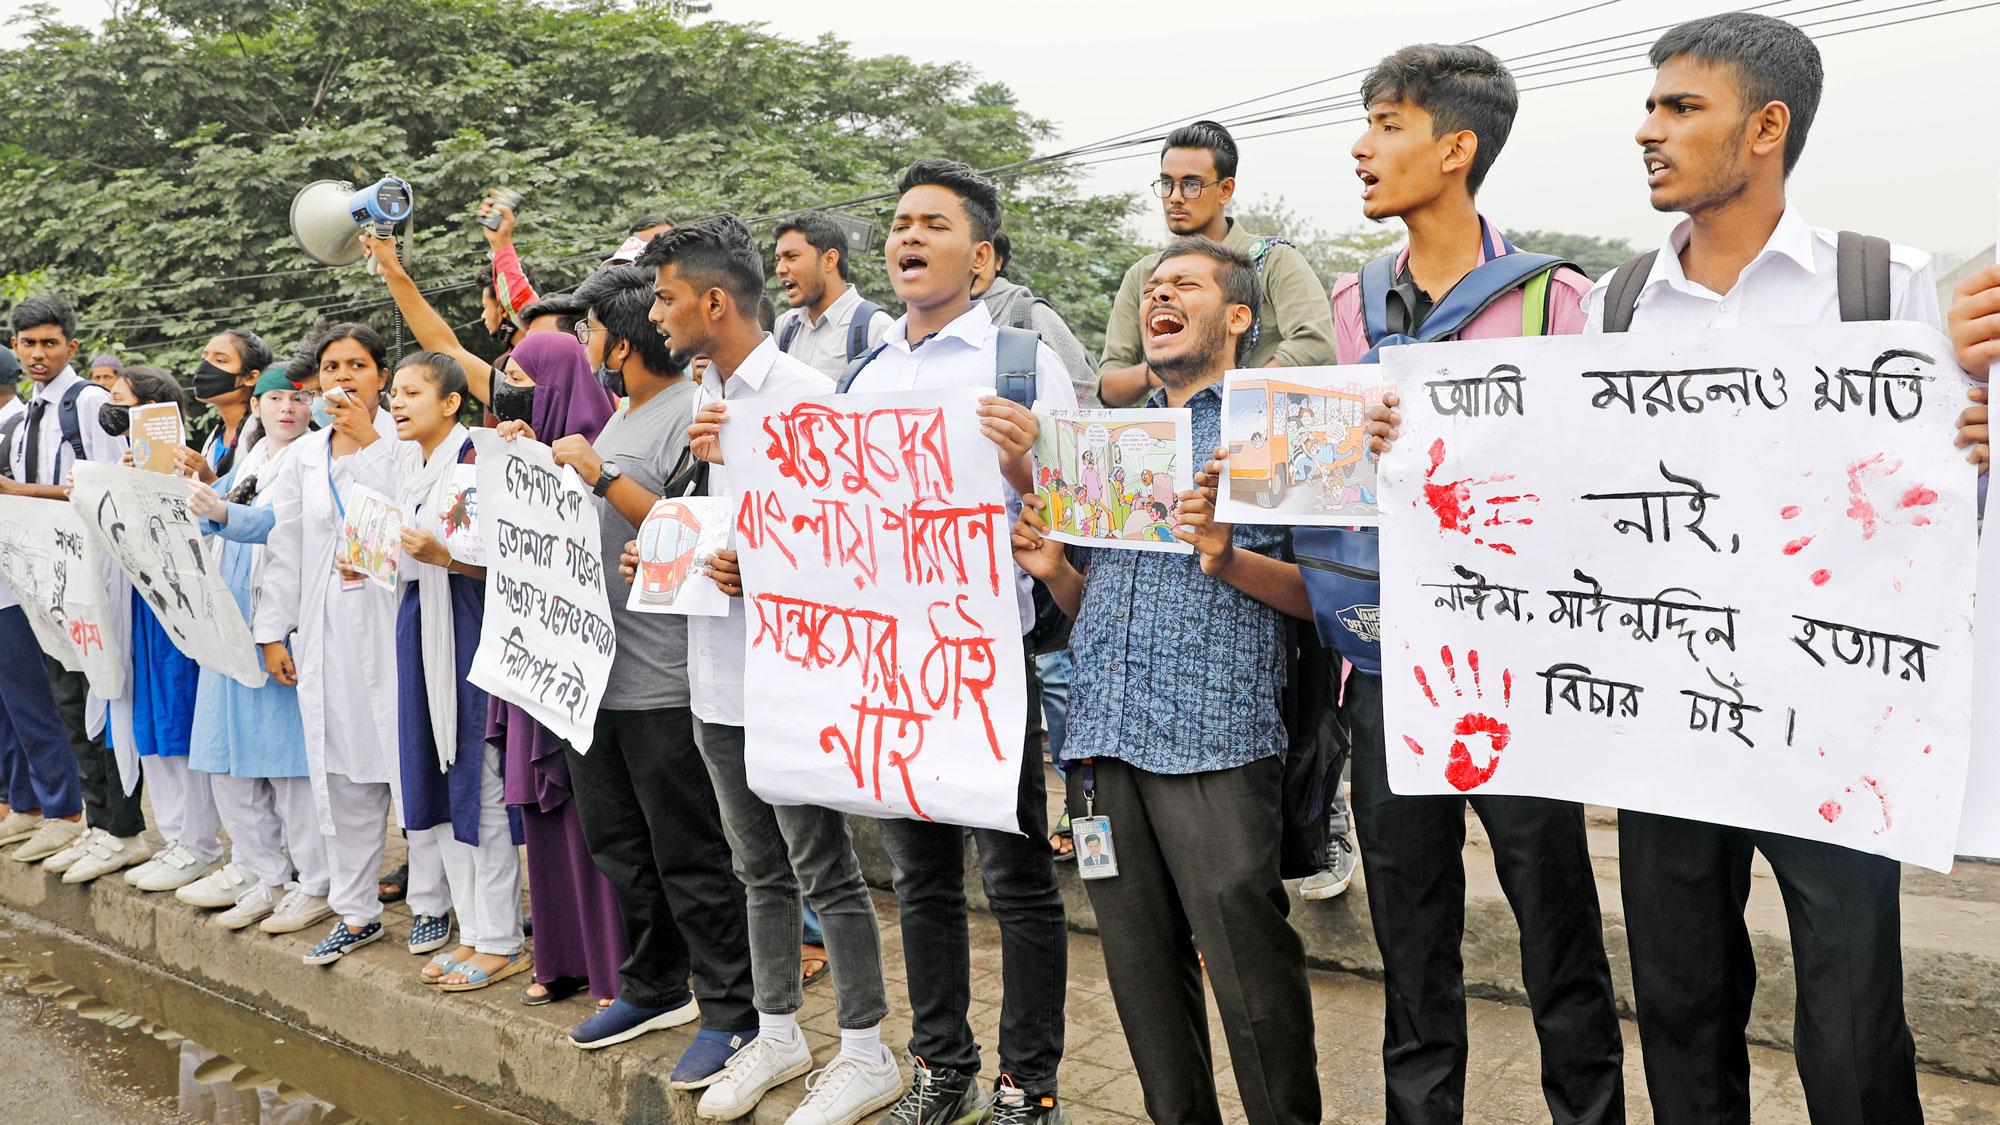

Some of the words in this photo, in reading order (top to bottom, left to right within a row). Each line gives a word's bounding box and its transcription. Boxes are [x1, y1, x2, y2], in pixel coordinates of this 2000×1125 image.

[1425, 364, 1527, 418] আমি
[1581, 367, 1790, 417] মরলেও
[1814, 349, 1940, 422] ক্ষতি
[497, 518, 560, 570] তোমার
[500, 626, 558, 704] নিরাপদ
[1791, 614, 1940, 683] হত্যার
[1536, 663, 1645, 720] বিচার
